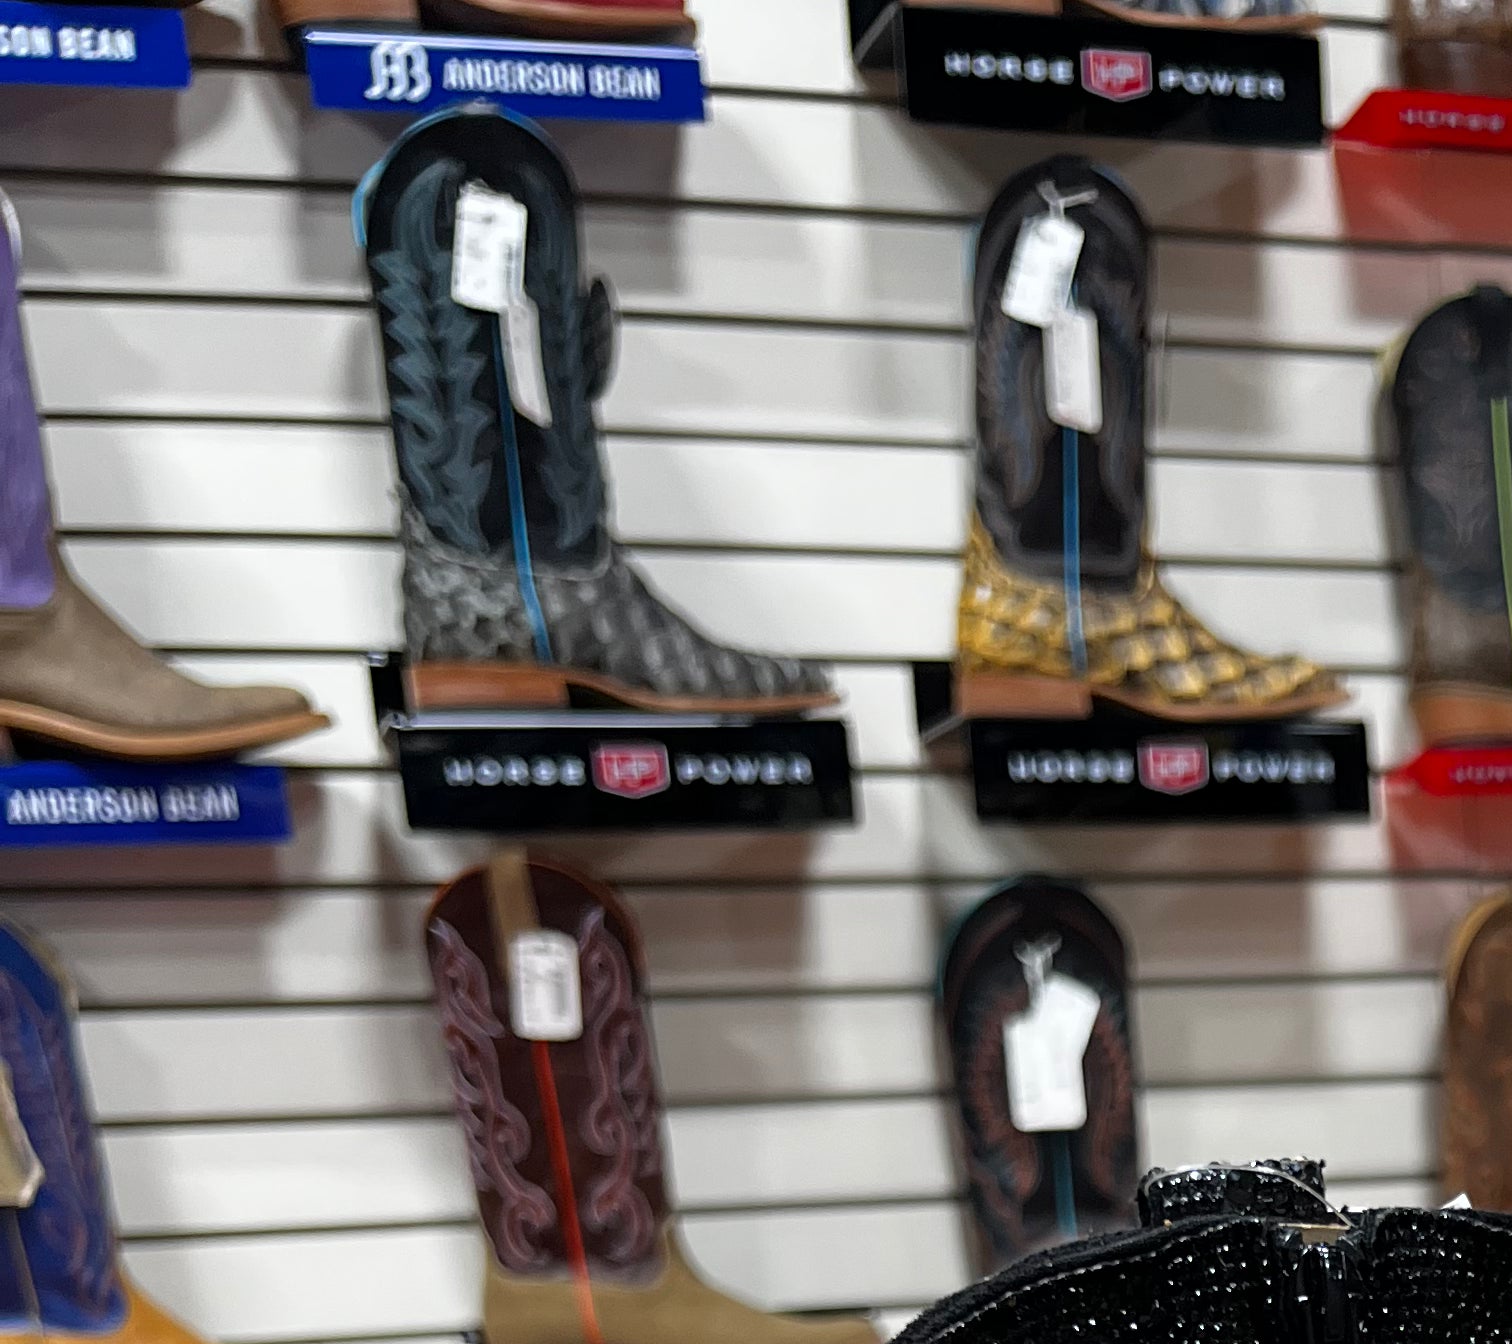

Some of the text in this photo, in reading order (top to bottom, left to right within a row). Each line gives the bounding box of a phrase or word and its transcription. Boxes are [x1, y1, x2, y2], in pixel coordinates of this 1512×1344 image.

[442, 57, 586, 97] ANDERSON
[588, 64, 662, 101] BEAN
[944, 52, 1075, 86] HORSE
[1158, 67, 1286, 100] POWER
[442, 755, 586, 786] HORSE
[675, 752, 814, 786] POWER
[1212, 749, 1336, 783] POWER
[7, 786, 159, 825] ANDERSON
